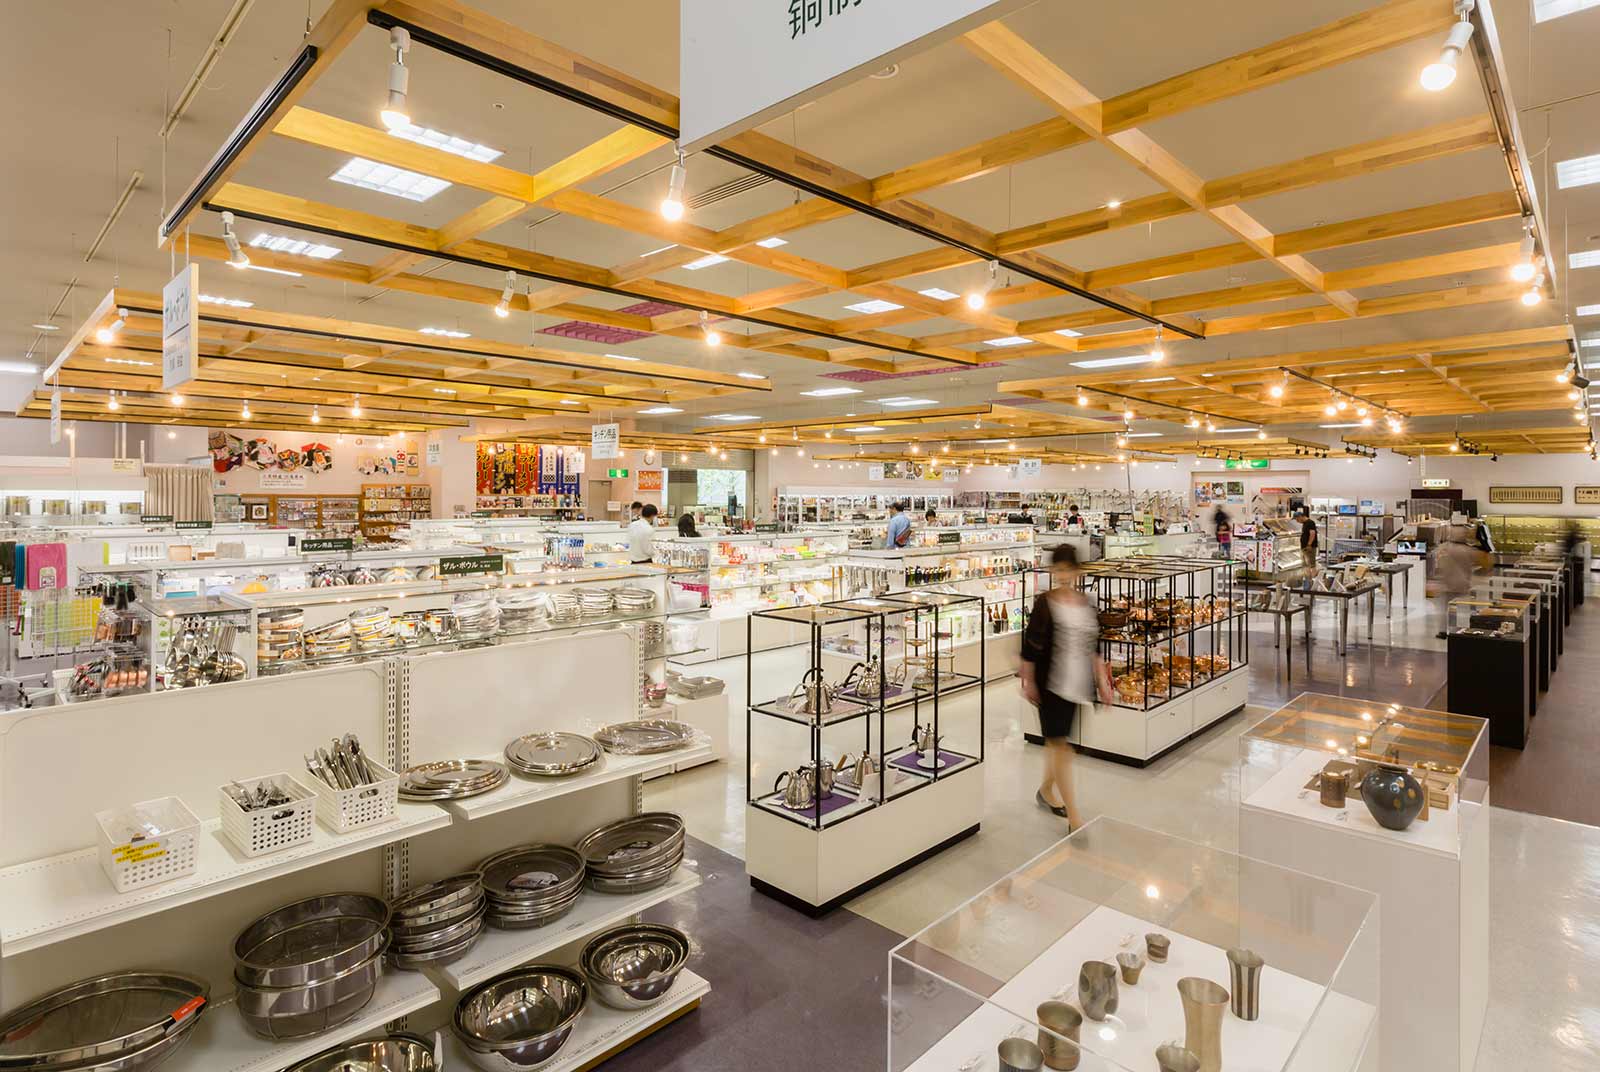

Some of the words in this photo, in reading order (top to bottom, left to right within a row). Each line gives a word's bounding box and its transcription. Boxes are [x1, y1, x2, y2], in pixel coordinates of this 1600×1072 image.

[304, 541, 333, 549] キッチン用品
[442, 561, 479, 570] ザル・ボウル
